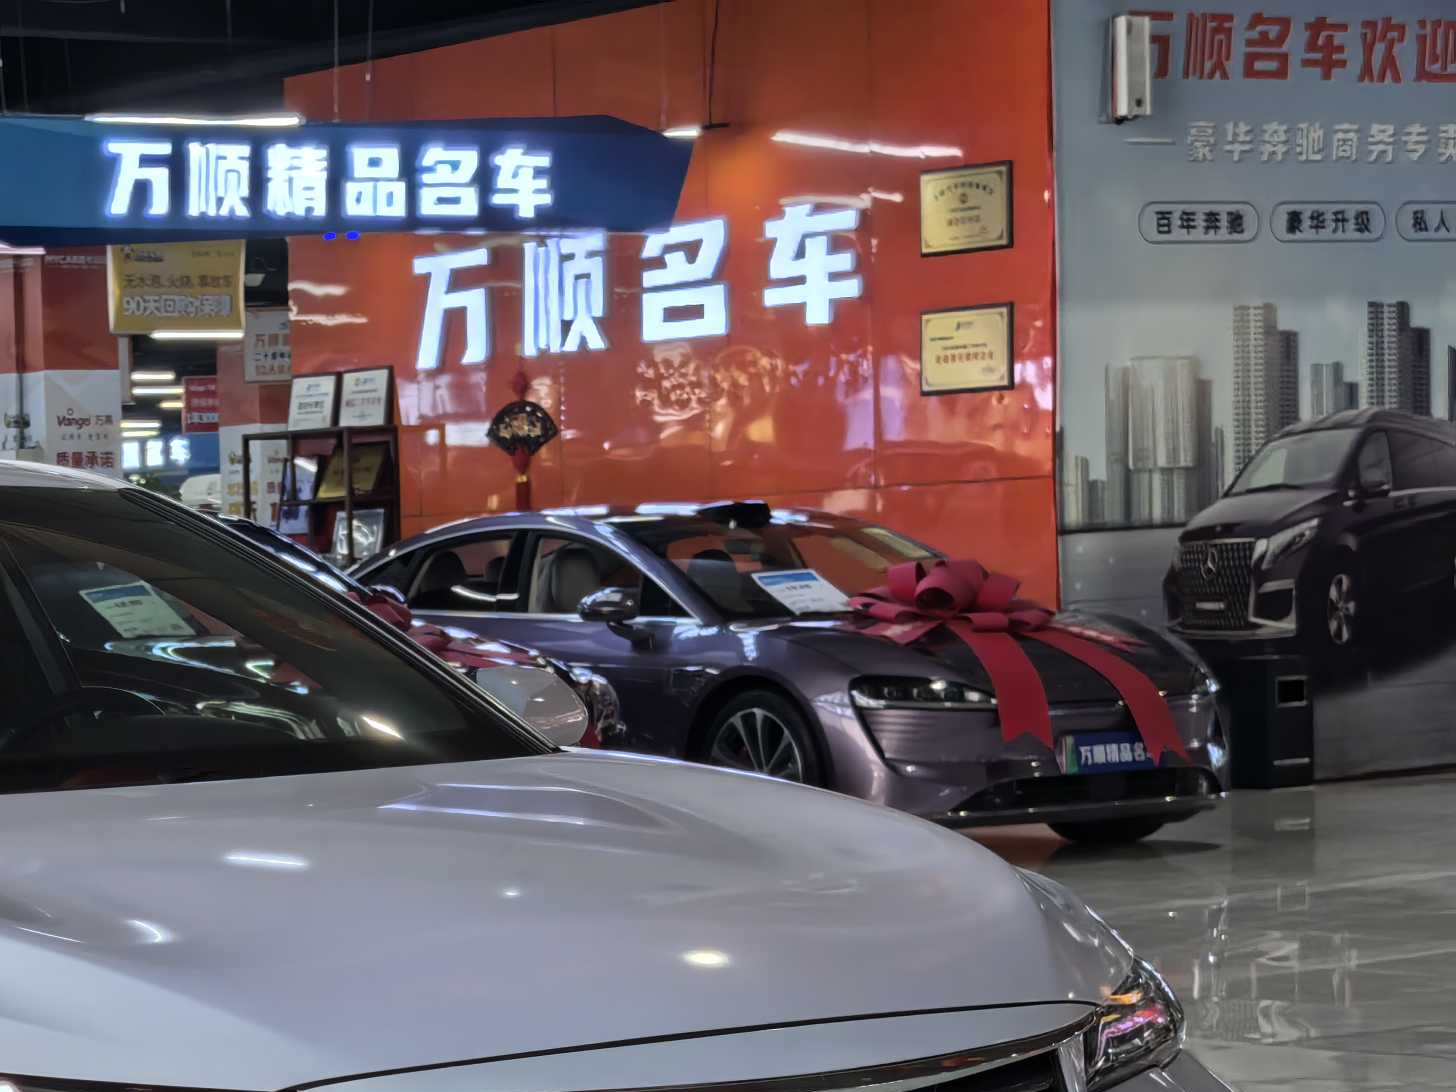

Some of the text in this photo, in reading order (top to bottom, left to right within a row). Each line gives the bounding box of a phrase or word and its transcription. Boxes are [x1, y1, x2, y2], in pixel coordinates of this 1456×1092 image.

[105, 138, 553, 219] 万顺精品名车
[1155, 210, 1246, 236] 百年奔驰
[1285, 209, 1373, 235] 豪华升级
[412, 202, 863, 371] 万顺名车
[1079, 742, 1153, 766] 万顺精品名
